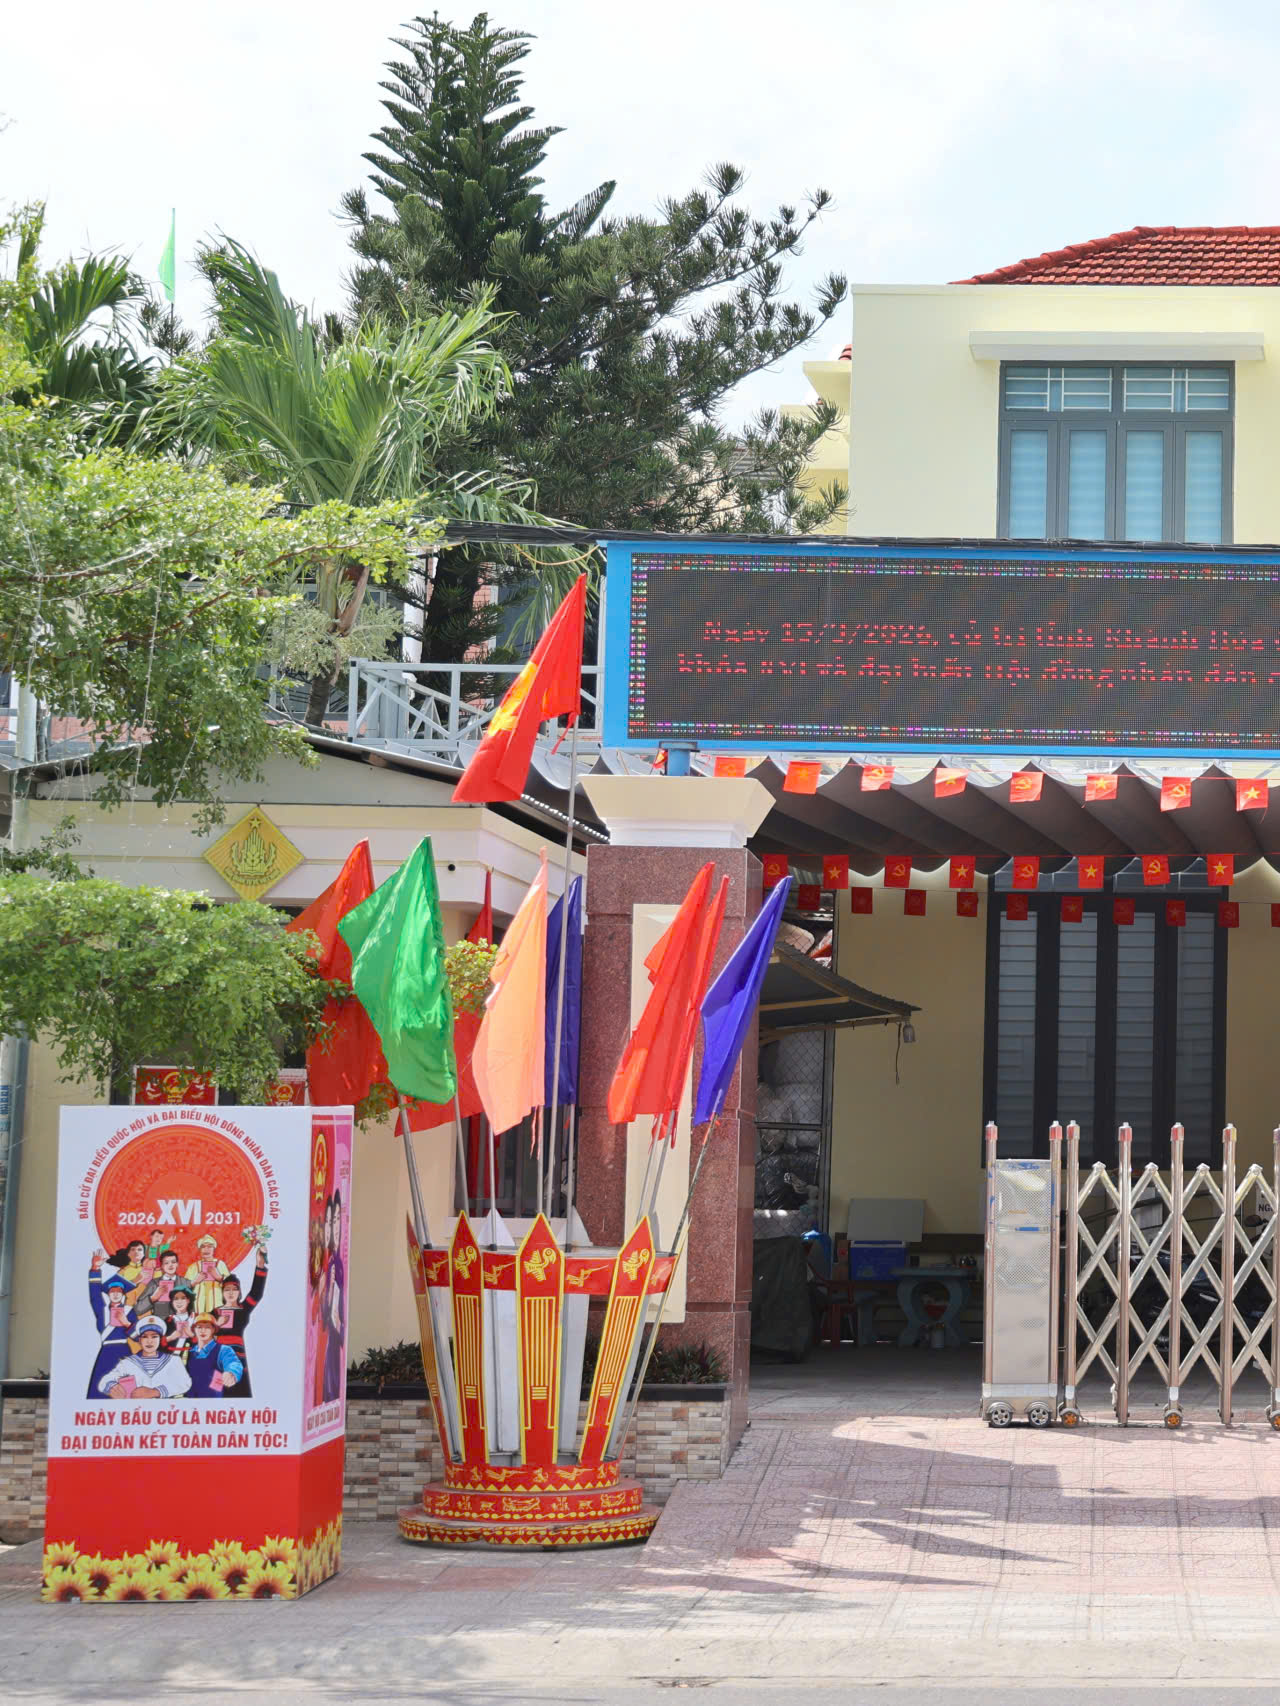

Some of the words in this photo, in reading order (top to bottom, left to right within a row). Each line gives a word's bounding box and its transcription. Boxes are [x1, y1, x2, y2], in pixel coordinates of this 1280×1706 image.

[147, 1112, 160, 1124] VÀ
[162, 1111, 178, 1122] ĐẠI
[180, 1107, 202, 1120] BIỂU
[204, 1113, 220, 1126] HỘI
[130, 1118, 146, 1132] HỘI
[220, 1119, 245, 1139] ĐỒNG
[107, 1127, 130, 1149] QUỐC
[92, 1147, 110, 1167] BIỂU
[242, 1136, 264, 1160] NHÂN
[84, 1167, 98, 1184] ĐẠI
[259, 1159, 274, 1178] DÂN
[78, 1184, 92, 1198] CỬ
[267, 1179, 280, 1198] CÁC
[76, 1201, 89, 1219] BẦU
[118, 1212, 155, 1225] 2026
[156, 1199, 201, 1225] XVI
[205, 1212, 241, 1225] 2031
[269, 1200, 283, 1220] CẤP
[74, 1408, 116, 1426] NGÀY
[121, 1405, 152, 1425] BẦU
[157, 1404, 180, 1425] CỬ
[182, 1407, 200, 1425] LÀ
[205, 1407, 246, 1424] NGÀY
[251, 1407, 277, 1428] HỘI
[61, 1435, 87, 1453] ĐẠI
[92, 1431, 134, 1449] ĐOÀN
[139, 1429, 167, 1449] KẾT
[172, 1430, 212, 1449] TOÀN
[217, 1431, 250, 1448] DÂN
[254, 1430, 288, 1451] TỘC!
